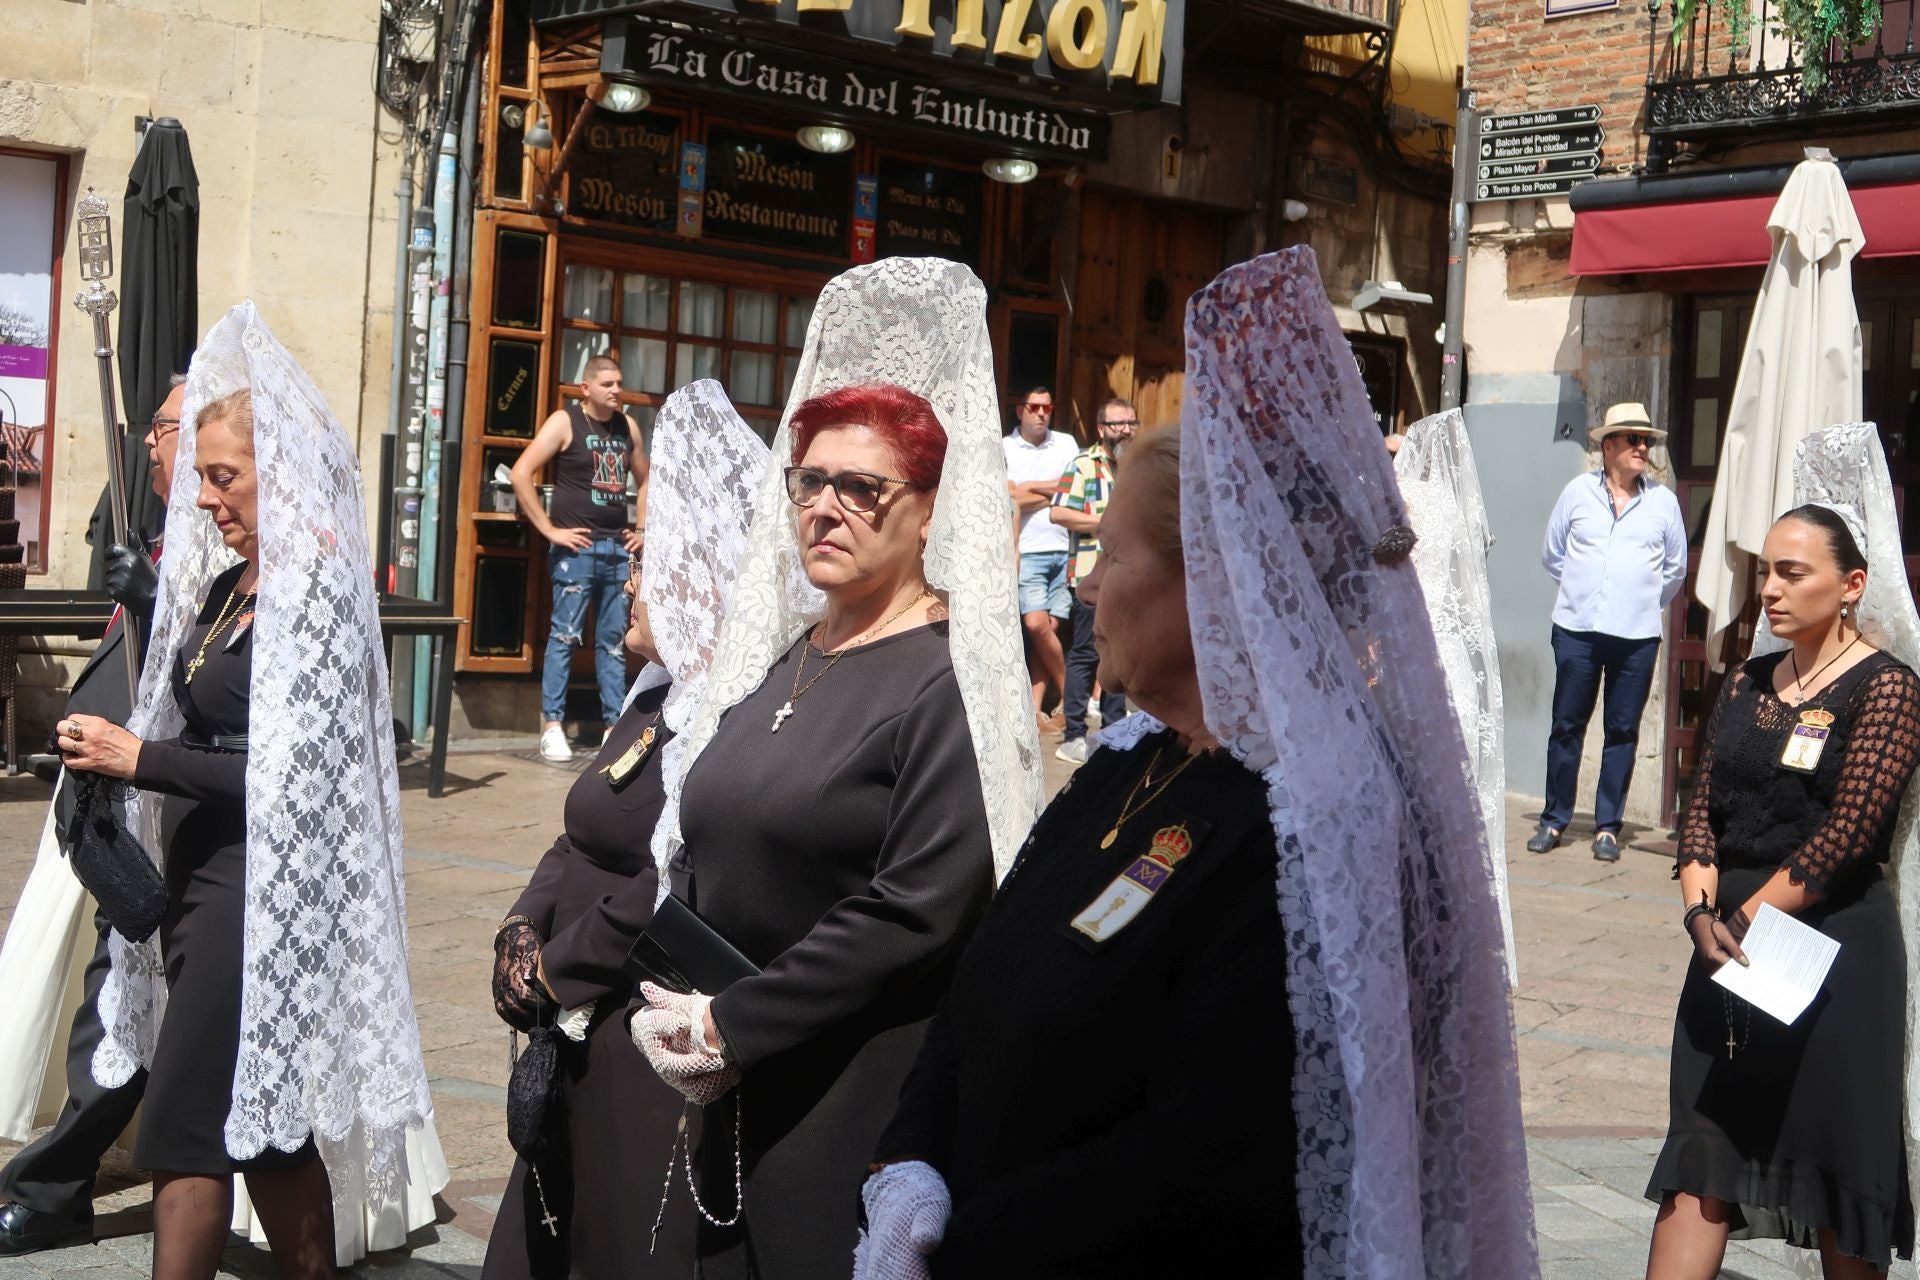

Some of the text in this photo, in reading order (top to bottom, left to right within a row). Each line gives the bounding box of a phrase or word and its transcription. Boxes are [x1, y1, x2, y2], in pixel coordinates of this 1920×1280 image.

[648, 33, 1090, 149] La Casa del Embutido
[1496, 117, 1518, 129] Iglesia
[1520, 115, 1533, 126] San
[1495, 132, 1560, 147] Balcón del Pueblo
[1495, 141, 1568, 157] Mirador de la ciudad
[1167, 155, 1175, 177] 1
[1493, 164, 1537, 175] Plaza Mayor
[1492, 182, 1557, 195] Torre de los Ponce
[580, 177, 666, 220] Mesón
[707, 190, 838, 238] Restaurante
[497, 367, 528, 411] Carnes
